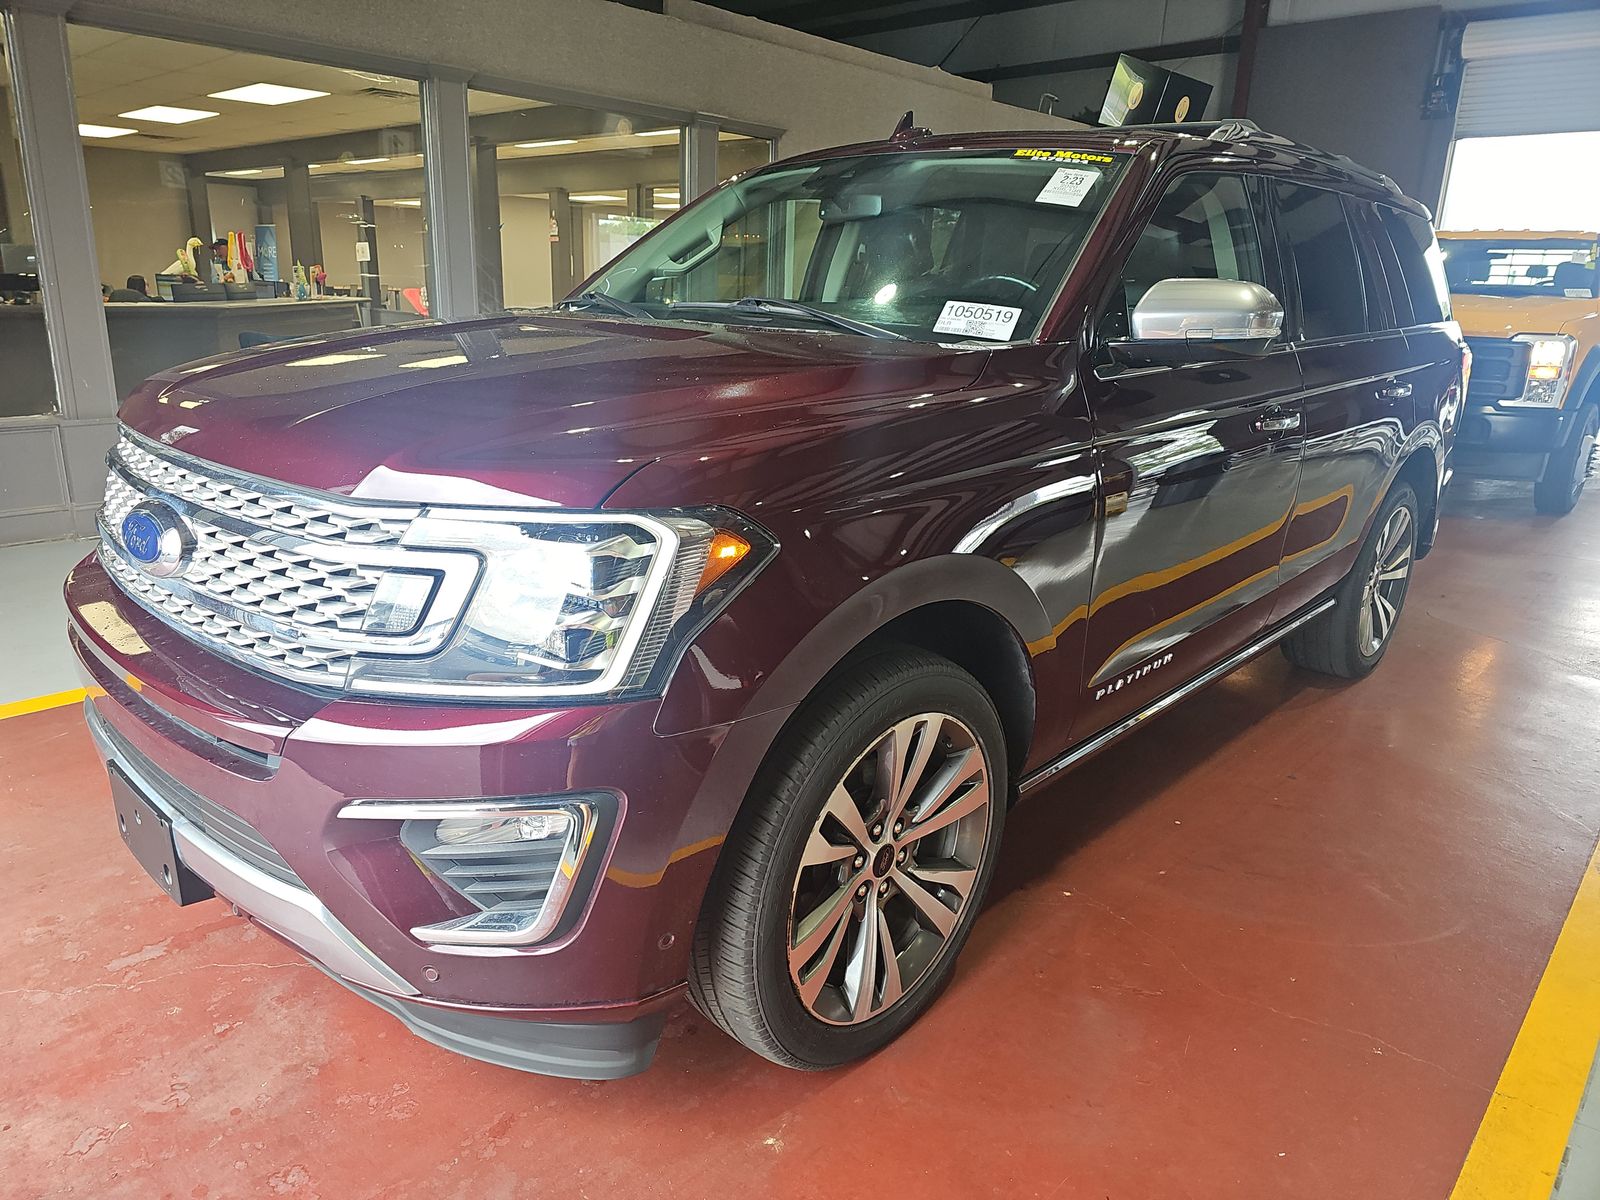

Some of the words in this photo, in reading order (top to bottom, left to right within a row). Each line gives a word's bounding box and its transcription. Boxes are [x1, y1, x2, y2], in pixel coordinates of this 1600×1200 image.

[1013, 149, 1052, 157] Elite
[1054, 150, 1113, 163] Motors
[947, 304, 1014, 324] 1050519
[124, 519, 151, 555] Ford
[1095, 653, 1173, 700] PLATINUM
